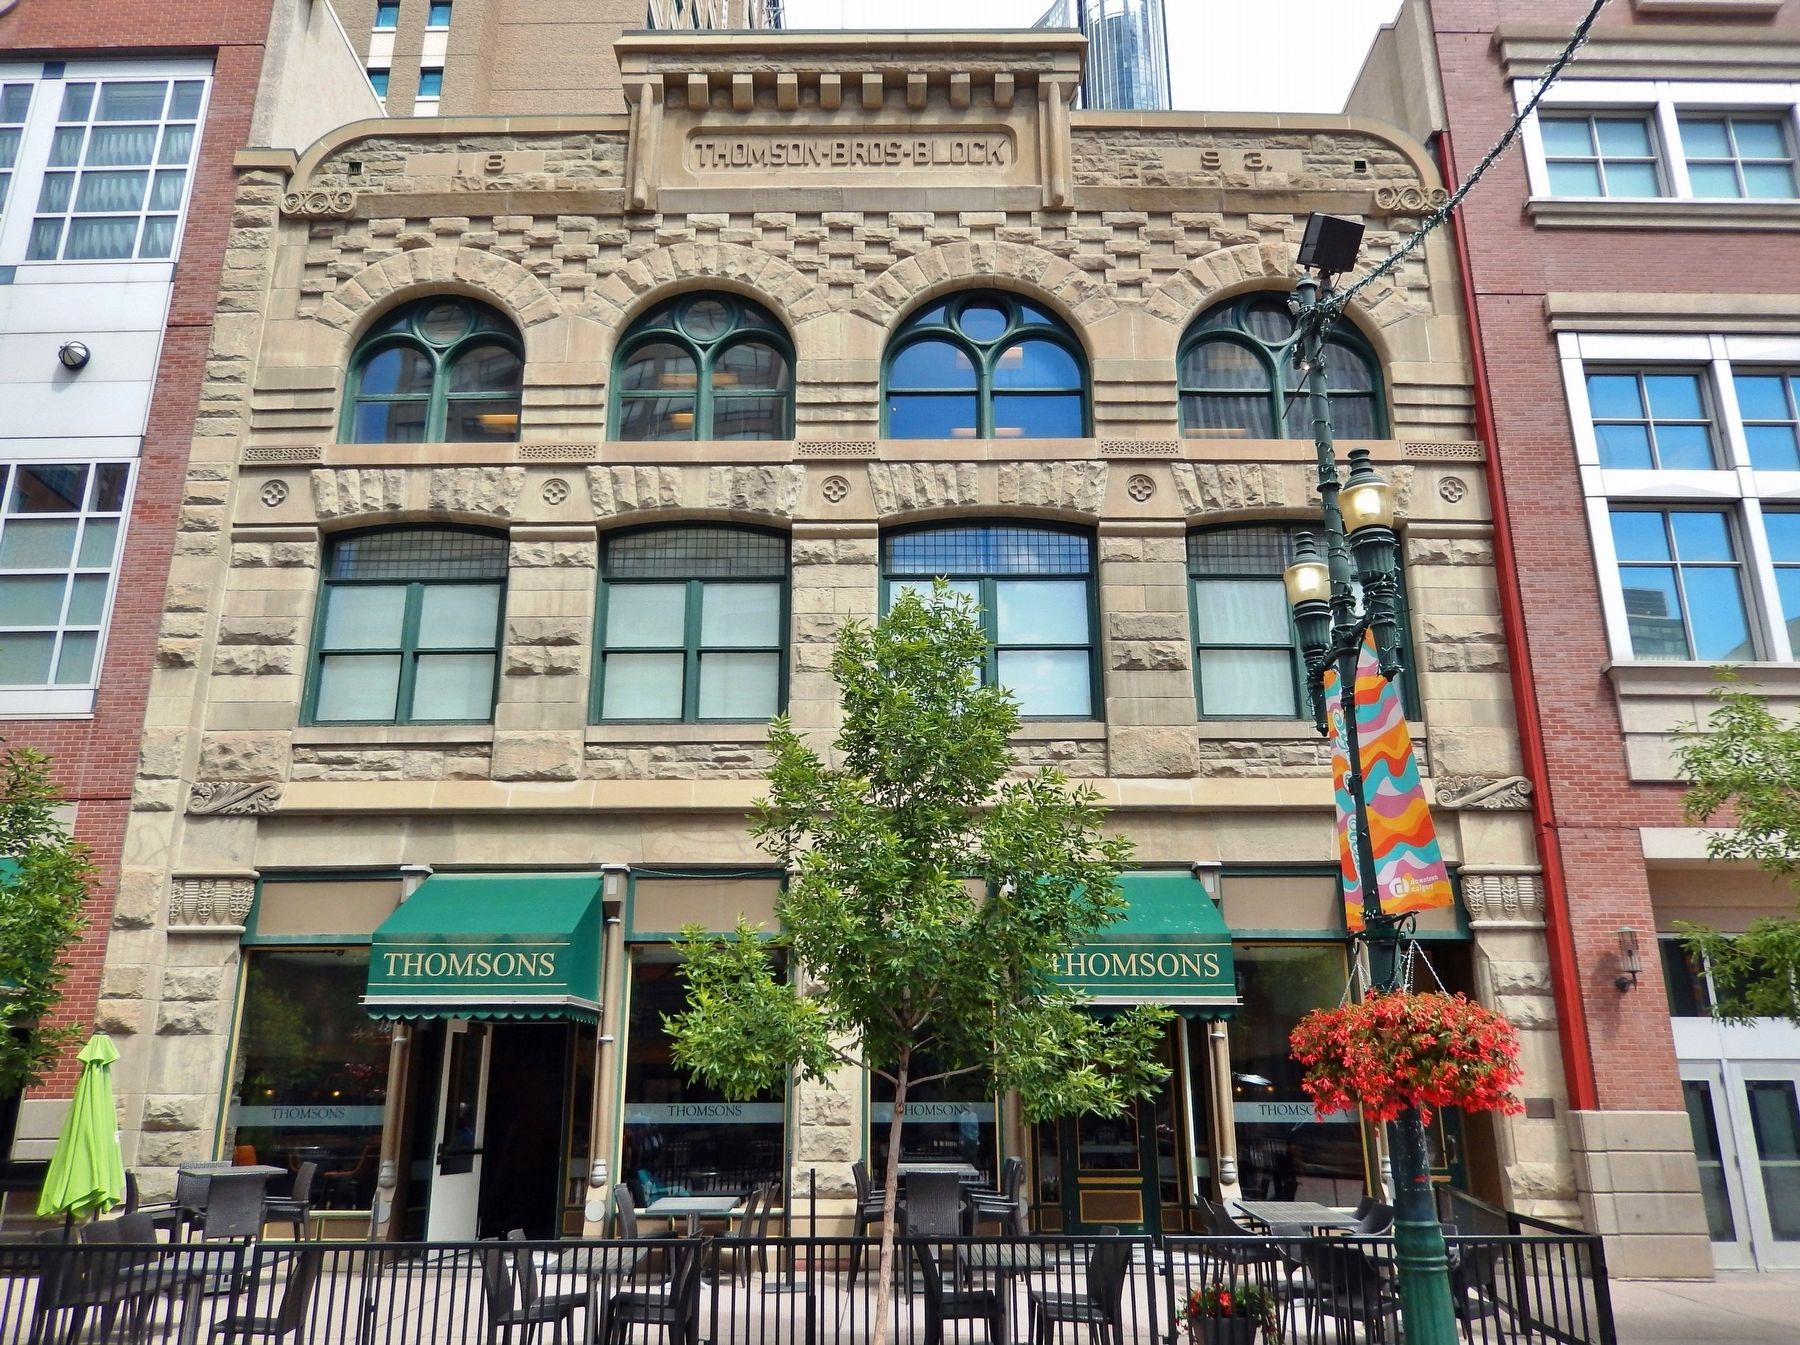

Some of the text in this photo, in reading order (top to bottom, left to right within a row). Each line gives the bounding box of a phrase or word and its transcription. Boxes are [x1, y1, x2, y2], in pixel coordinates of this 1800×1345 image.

[383, 951, 555, 977] THOMSONS
[271, 1107, 346, 1119] THOMSONS
[668, 1104, 742, 1117] THOMSONS
[903, 1104, 970, 1116] HOMSONS
